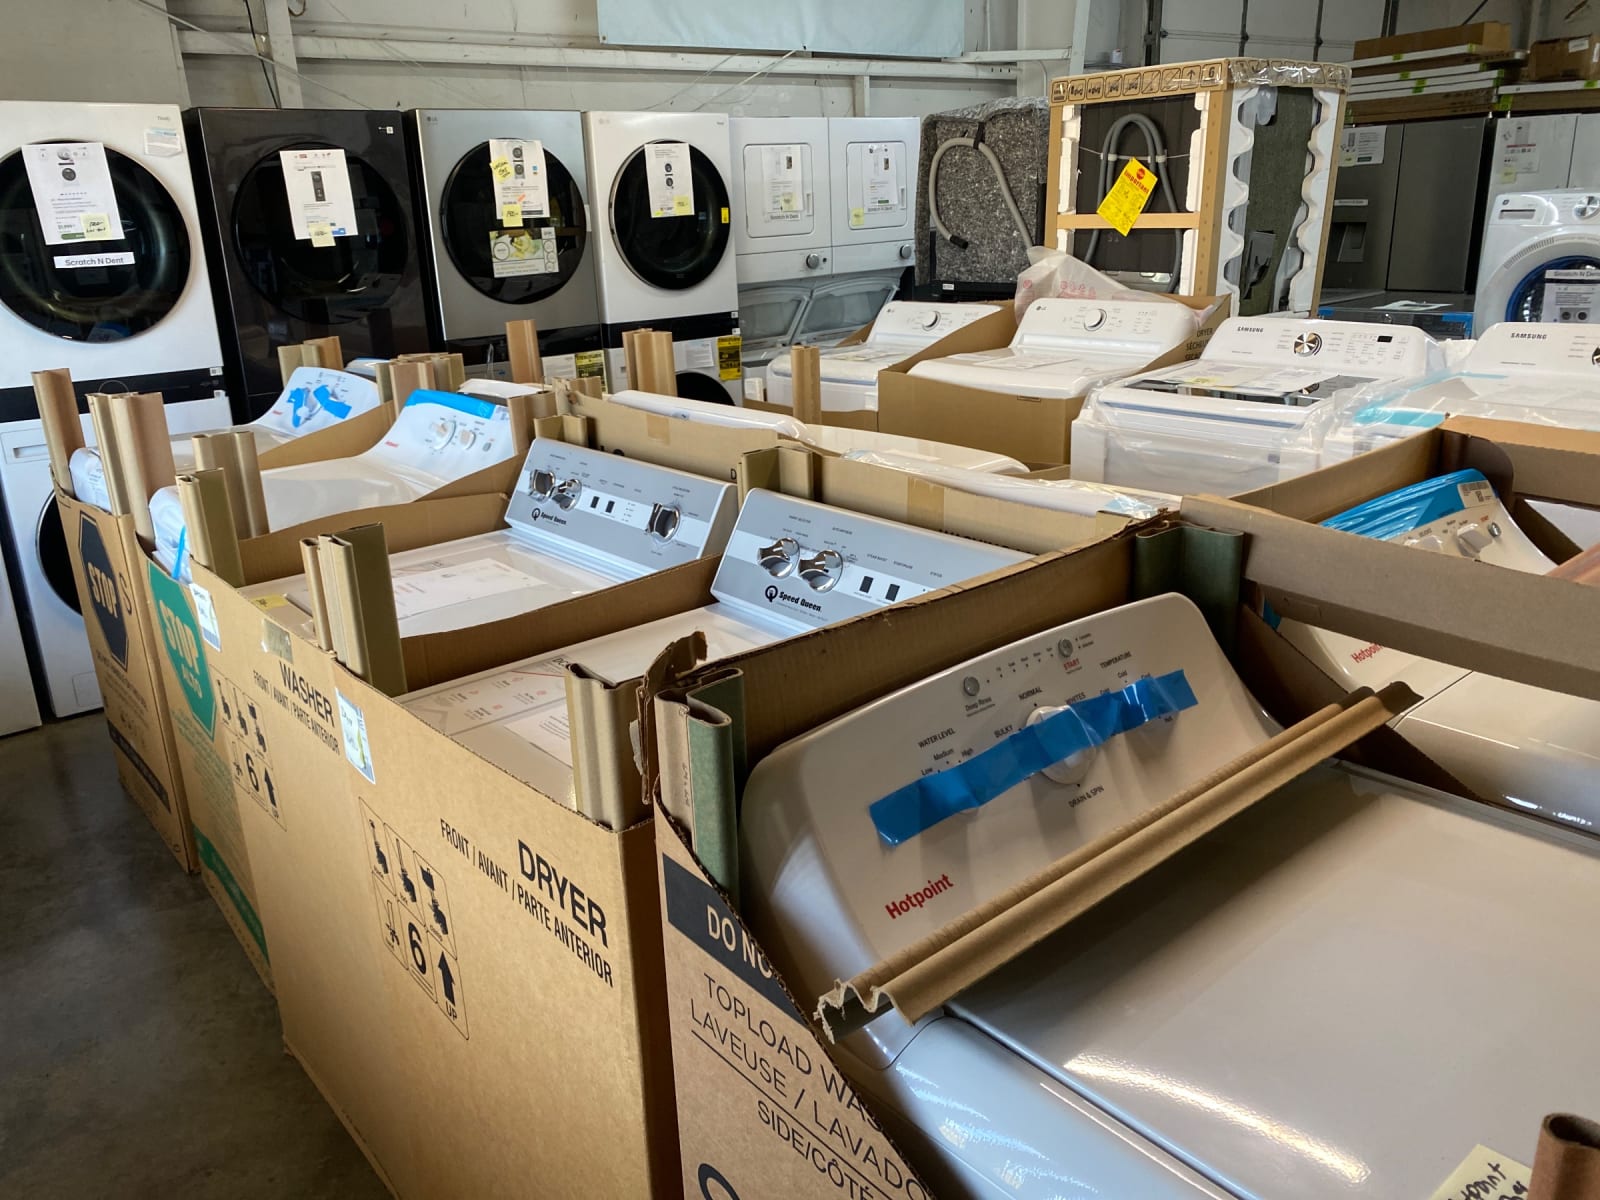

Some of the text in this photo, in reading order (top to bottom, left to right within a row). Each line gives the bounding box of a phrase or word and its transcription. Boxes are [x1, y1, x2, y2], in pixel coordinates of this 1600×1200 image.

[64, 258, 97, 266] Scratch
[1510, 332, 1548, 340] SAMSUNG
[88, 562, 118, 619] STOP
[779, 592, 800, 604] Speed
[800, 599, 822, 612] Queen
[160, 600, 200, 676] STOP
[1063, 658, 1080, 670] START
[1100, 651, 1132, 668] TEMPERATURE
[279, 659, 335, 728] WASHER
[1018, 687, 1042, 700] NORMAL
[918, 728, 956, 748] WATER LEVEL
[994, 725, 1013, 738] BULKY
[246, 752, 260, 792] 6
[1068, 796, 1087, 808] DRAIN
[1090, 785, 1104, 796] SPIN
[440, 818, 470, 860] FRONT
[478, 851, 509, 893] AVANT
[517, 883, 552, 932] PARTE
[554, 917, 614, 988] ANTERIOR
[518, 839, 608, 949] DRYER
[885, 874, 954, 920] Hotpoint
[706, 904, 737, 952] DO
[408, 921, 427, 976] 6
[446, 1002, 458, 1022] UP
[704, 972, 812, 1076] TOPLOAD
[690, 998, 787, 1099] LAVEUSE
